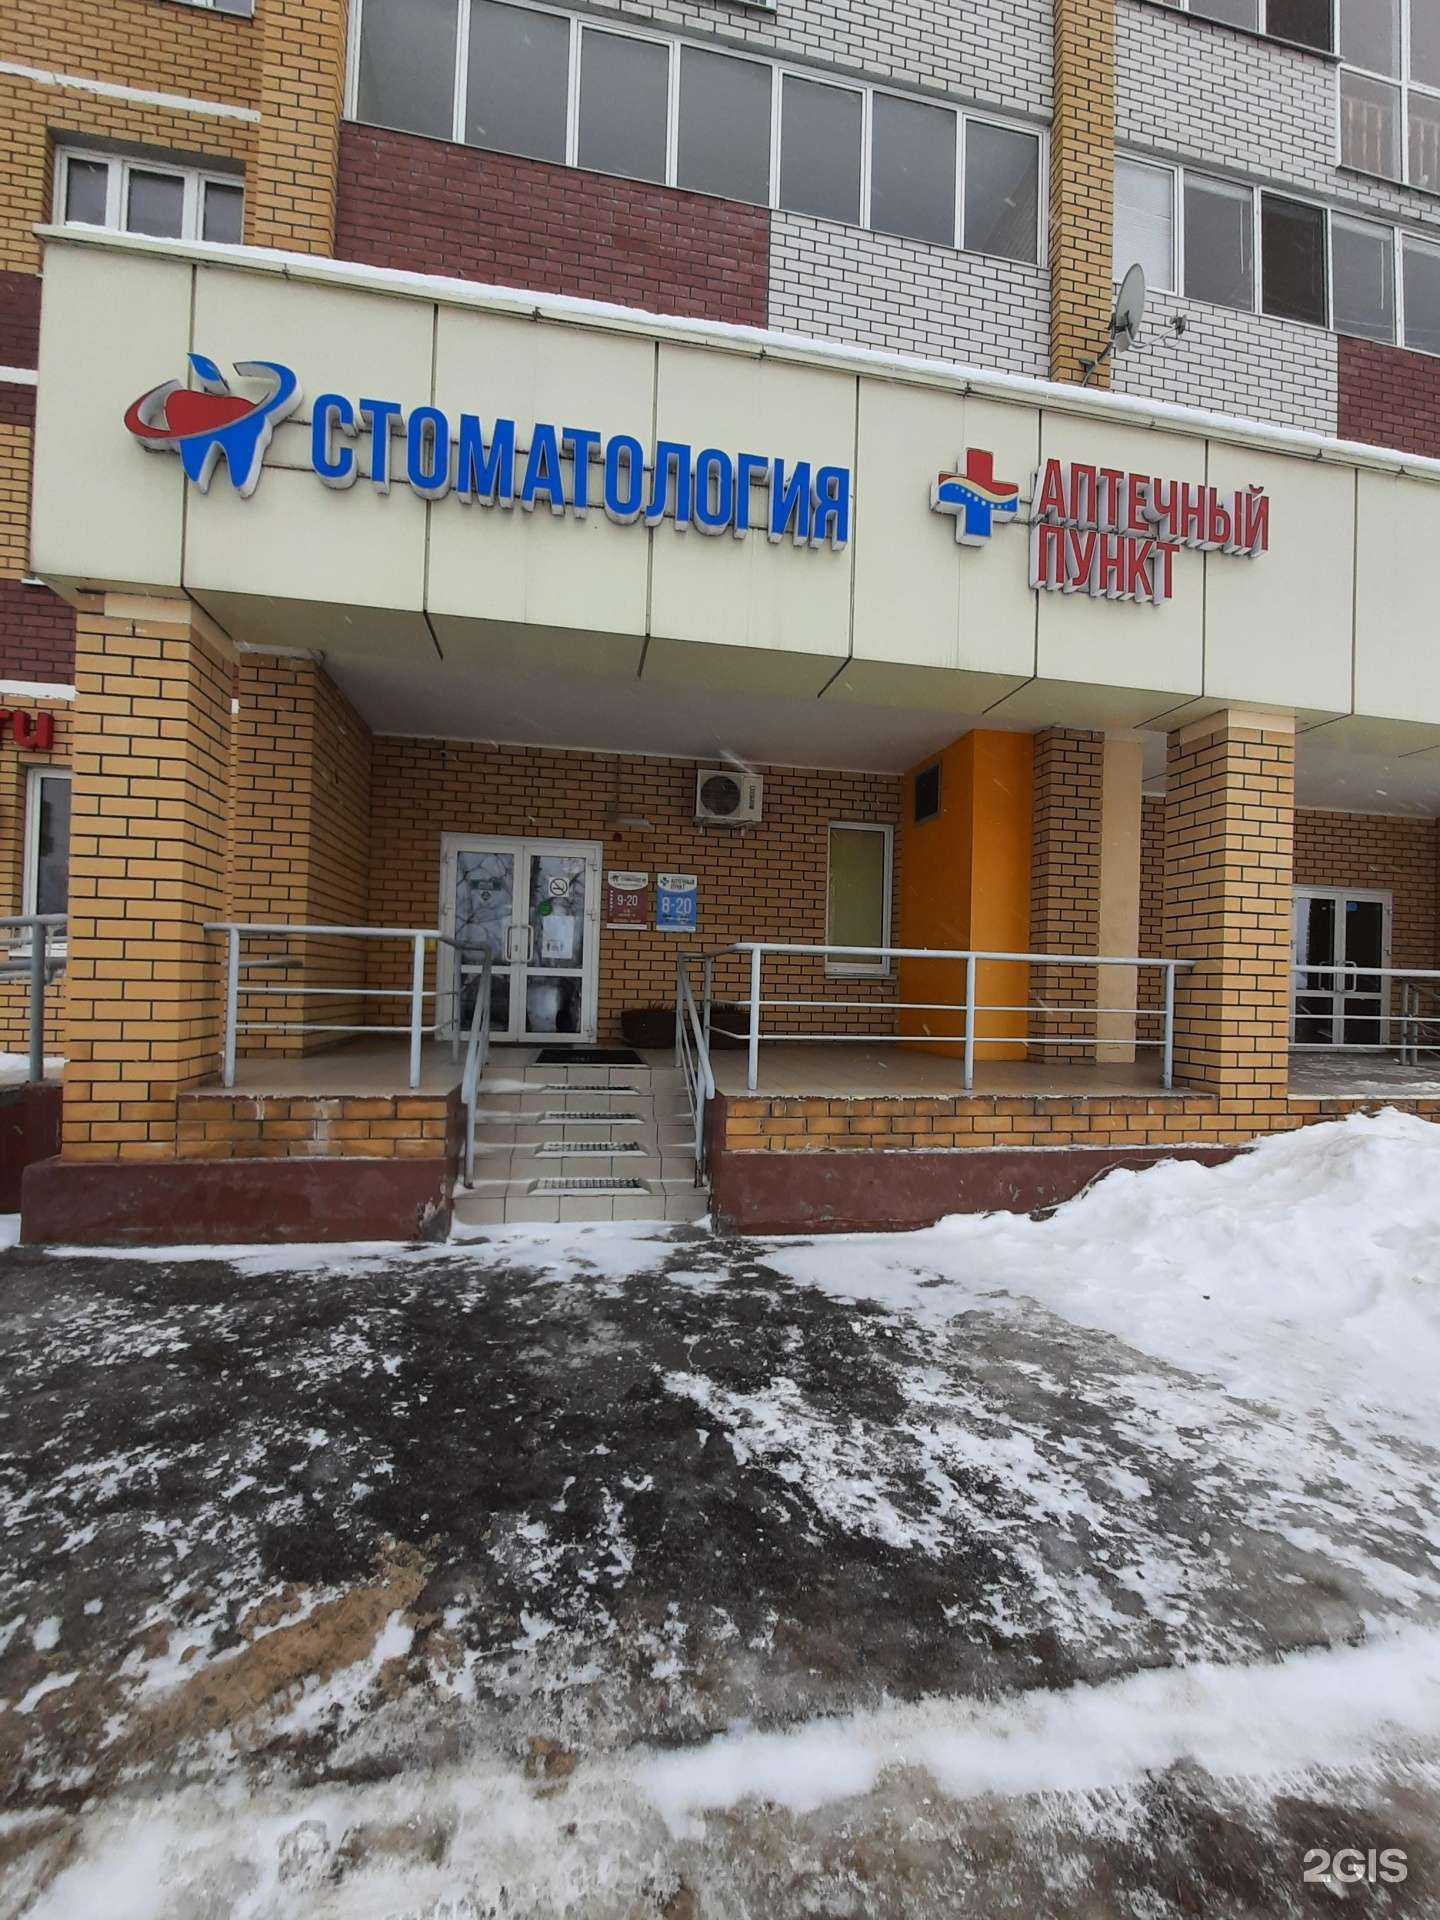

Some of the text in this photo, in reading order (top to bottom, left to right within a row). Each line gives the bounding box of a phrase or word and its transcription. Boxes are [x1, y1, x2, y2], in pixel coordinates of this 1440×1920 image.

[311, 393, 850, 546] СТОМАТОЛОГИЯ
[1036, 457, 1270, 553] АПТЕЧНЫЙ
[1035, 522, 1181, 601] ПУНКТ
